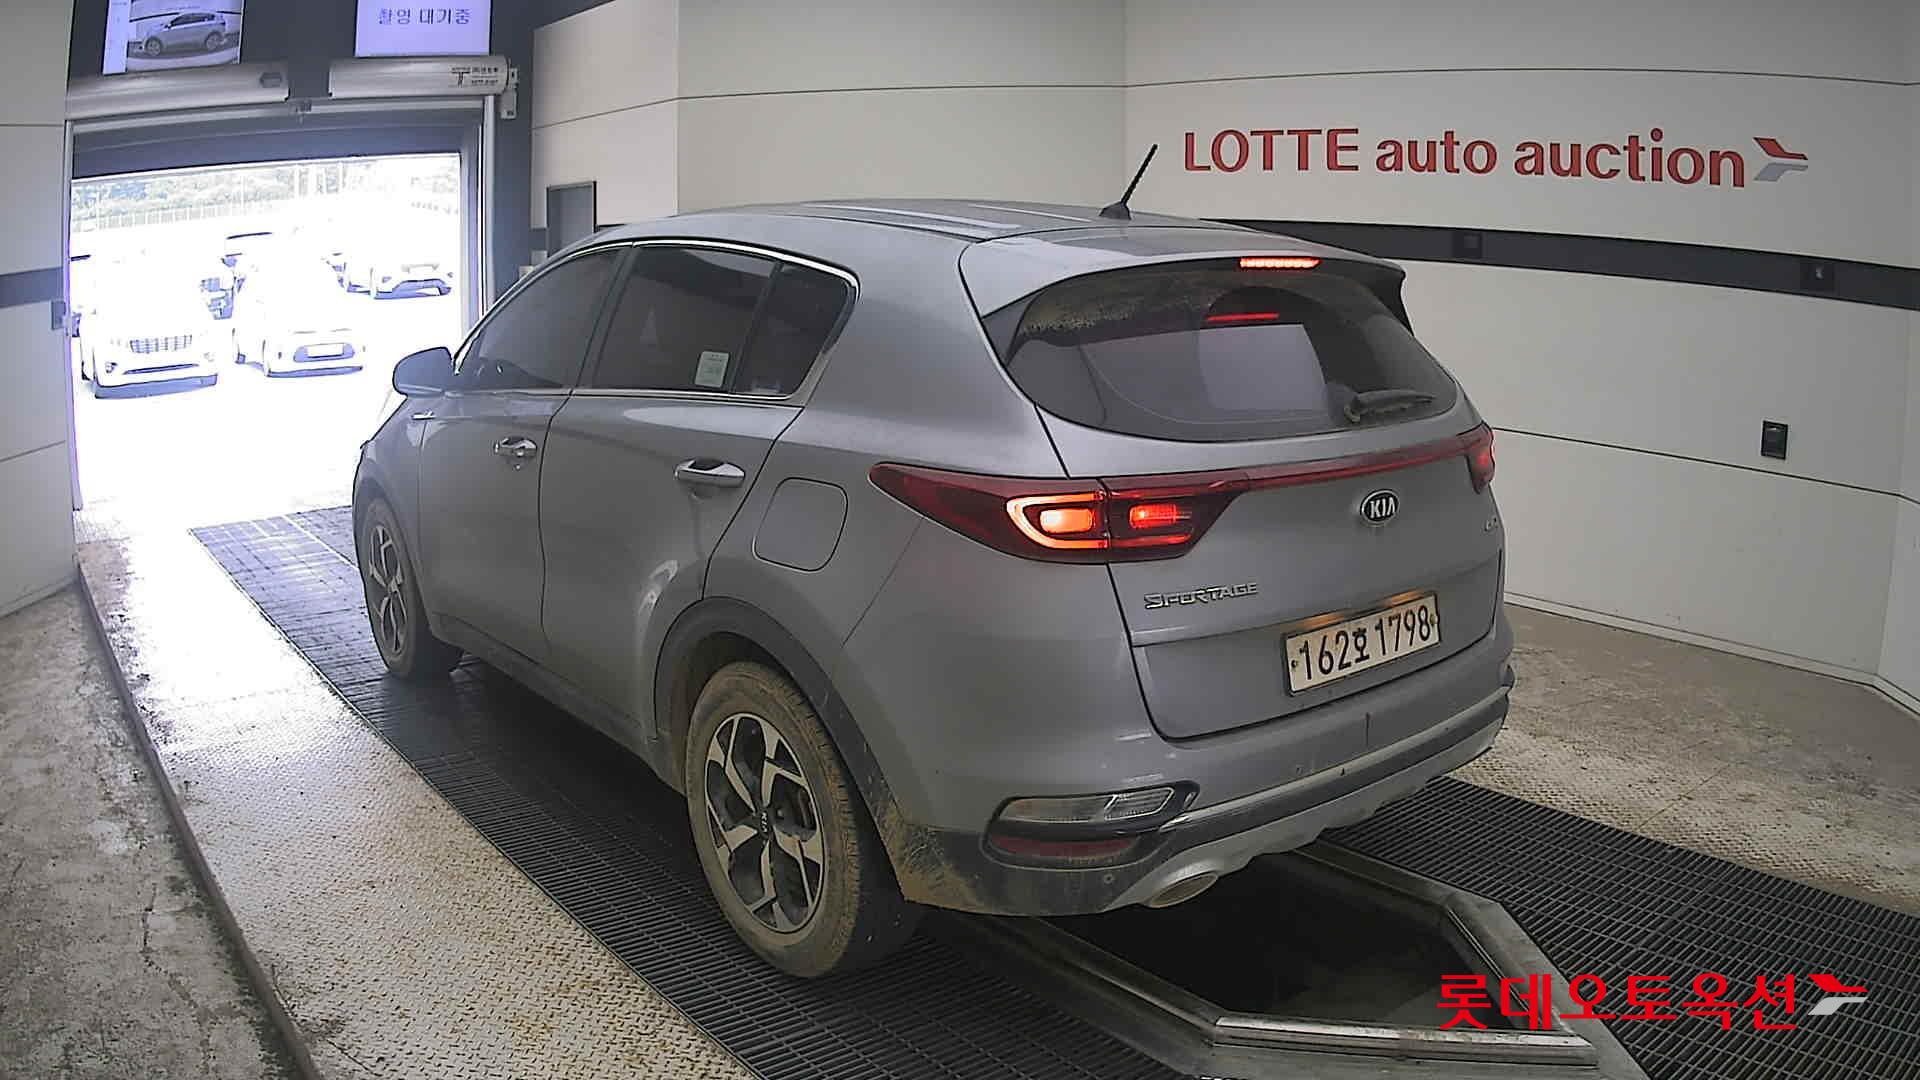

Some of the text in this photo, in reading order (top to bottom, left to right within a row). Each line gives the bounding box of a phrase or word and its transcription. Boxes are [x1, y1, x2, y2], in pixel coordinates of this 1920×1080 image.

[420, 7, 471, 25] 대기중
[1184, 127, 1745, 188] LOTTE auto auction
[1369, 496, 1396, 519] KIA
[1143, 582, 1259, 609] SPORTAGE
[1299, 605, 1431, 680] 162호 1798
